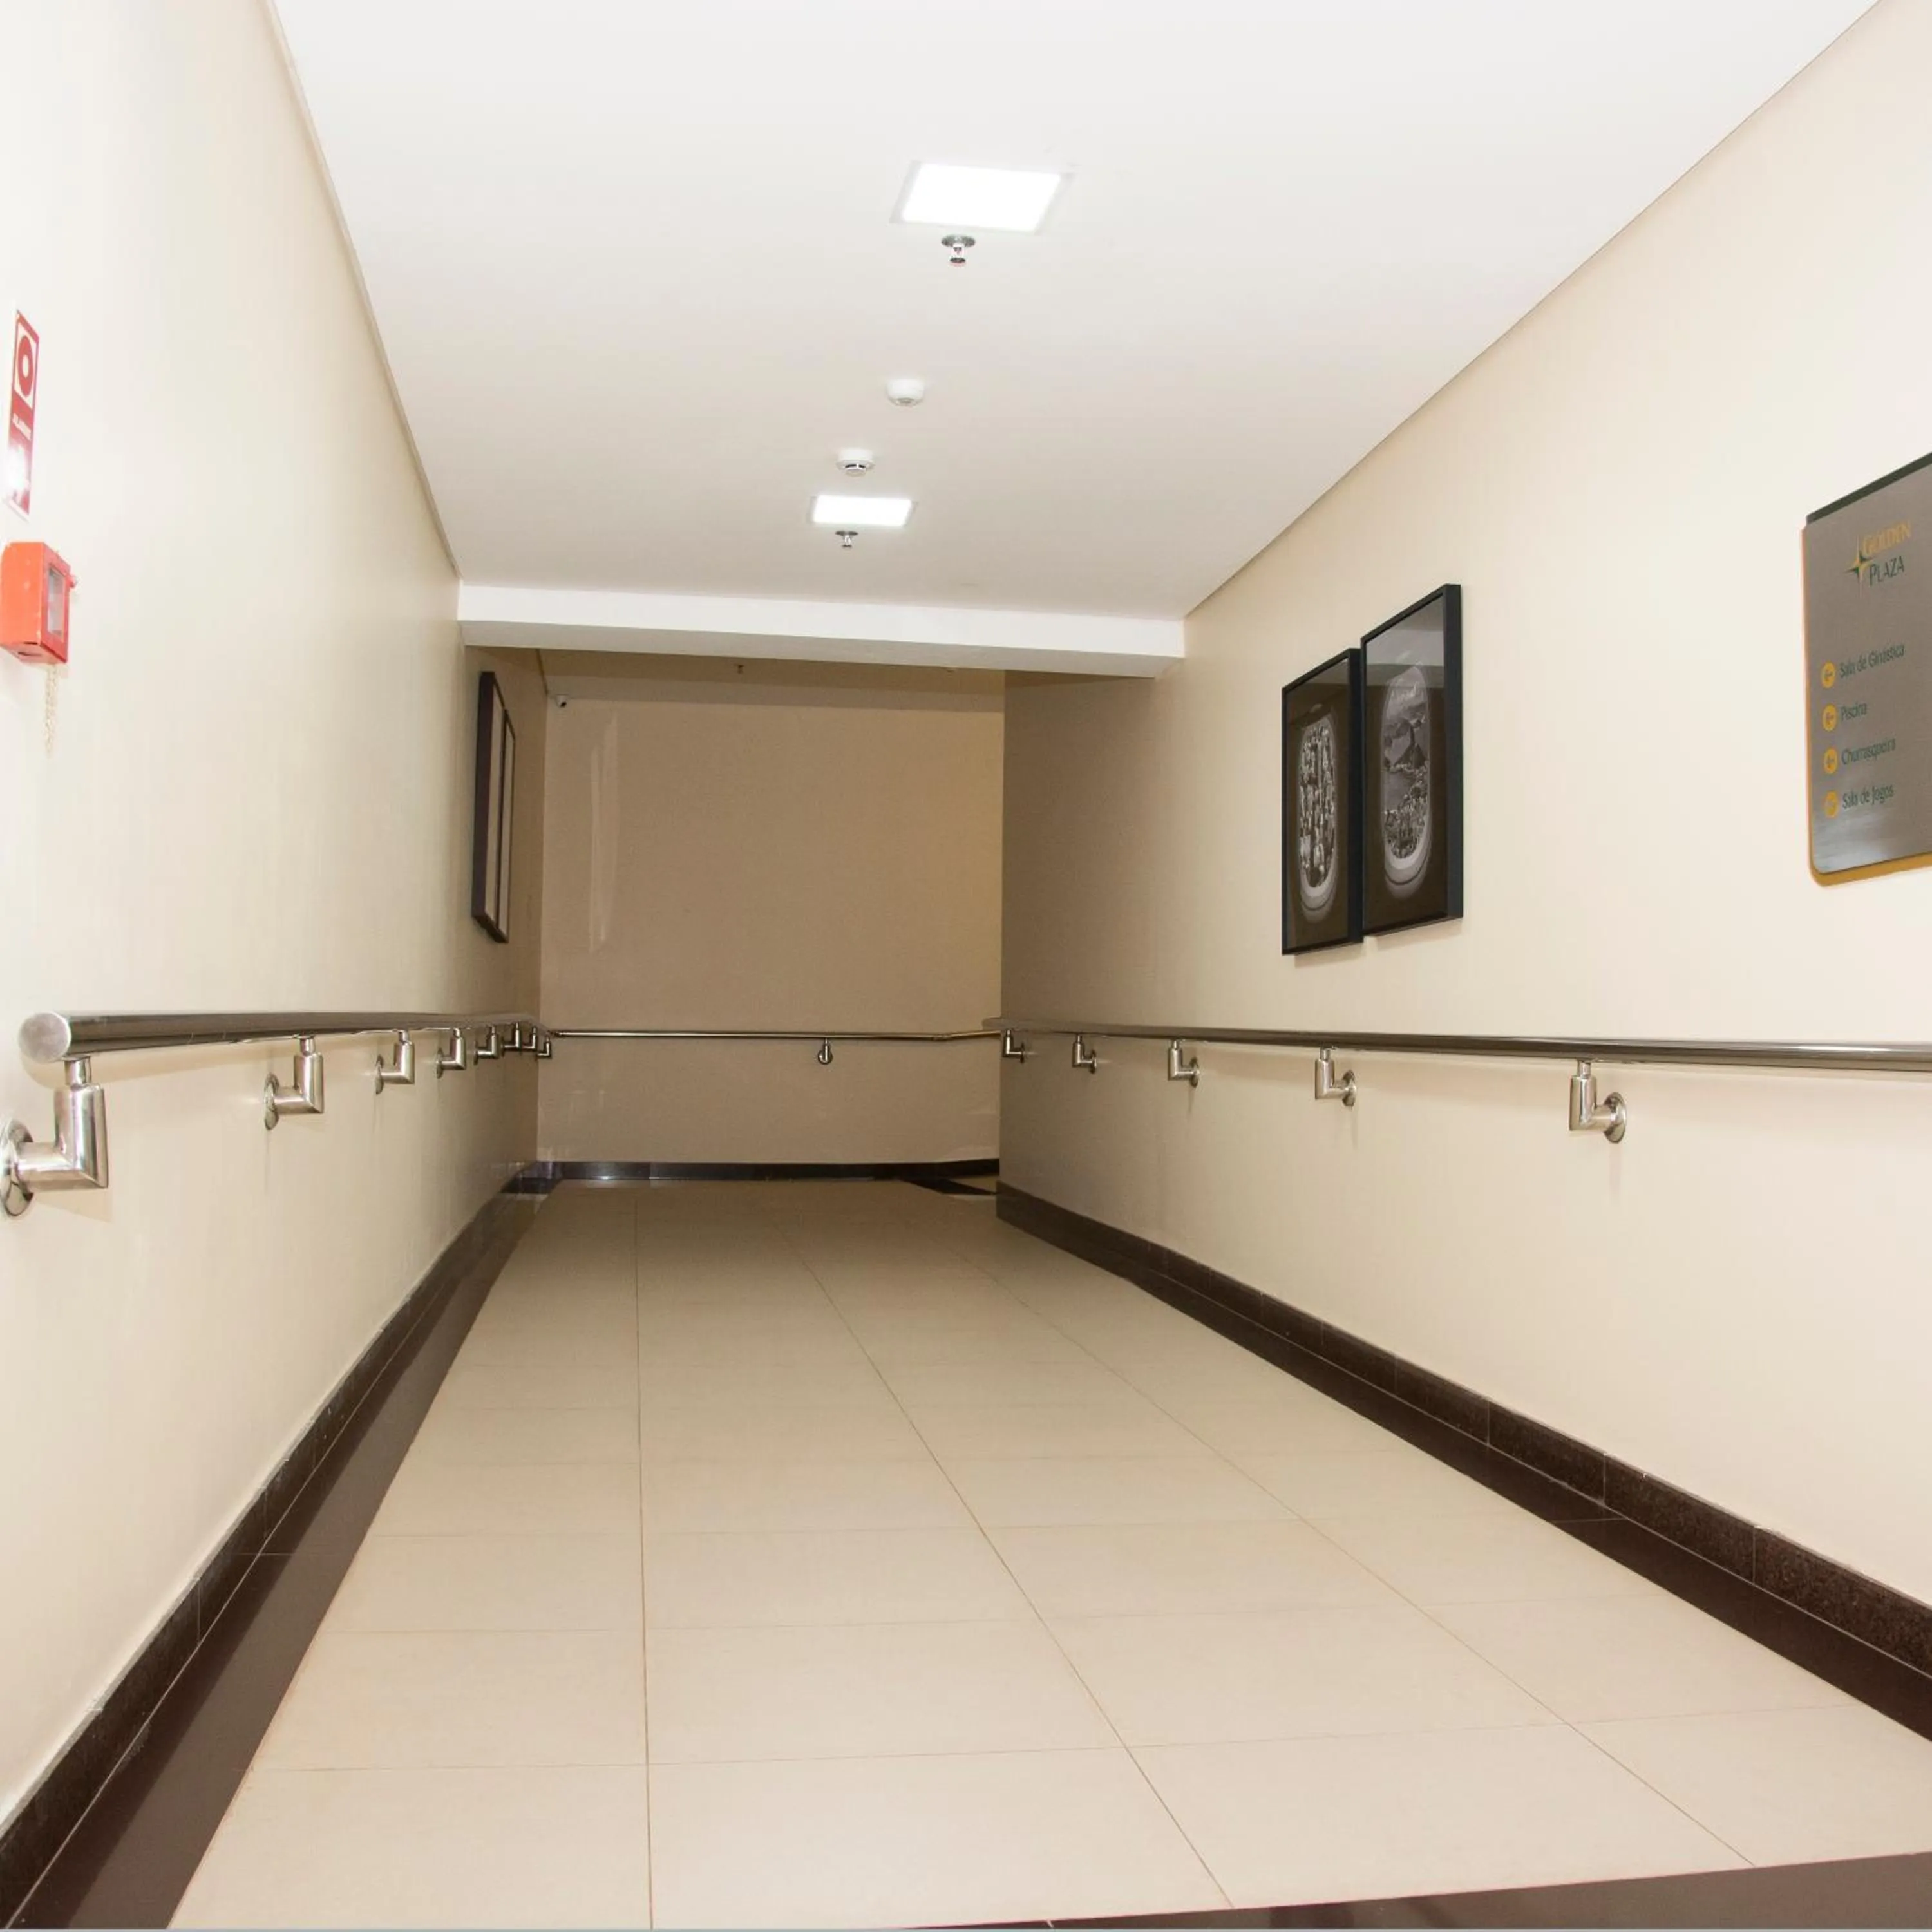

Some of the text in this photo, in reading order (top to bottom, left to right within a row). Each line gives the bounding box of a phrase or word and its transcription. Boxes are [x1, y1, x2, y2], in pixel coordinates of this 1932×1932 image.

[1870, 556, 1905, 587] PLAZA
[1840, 661, 1855, 678] Sala
[1857, 654, 1866, 672] de
[1842, 790, 1858, 809] Sala
[1861, 787, 1870, 804] de
